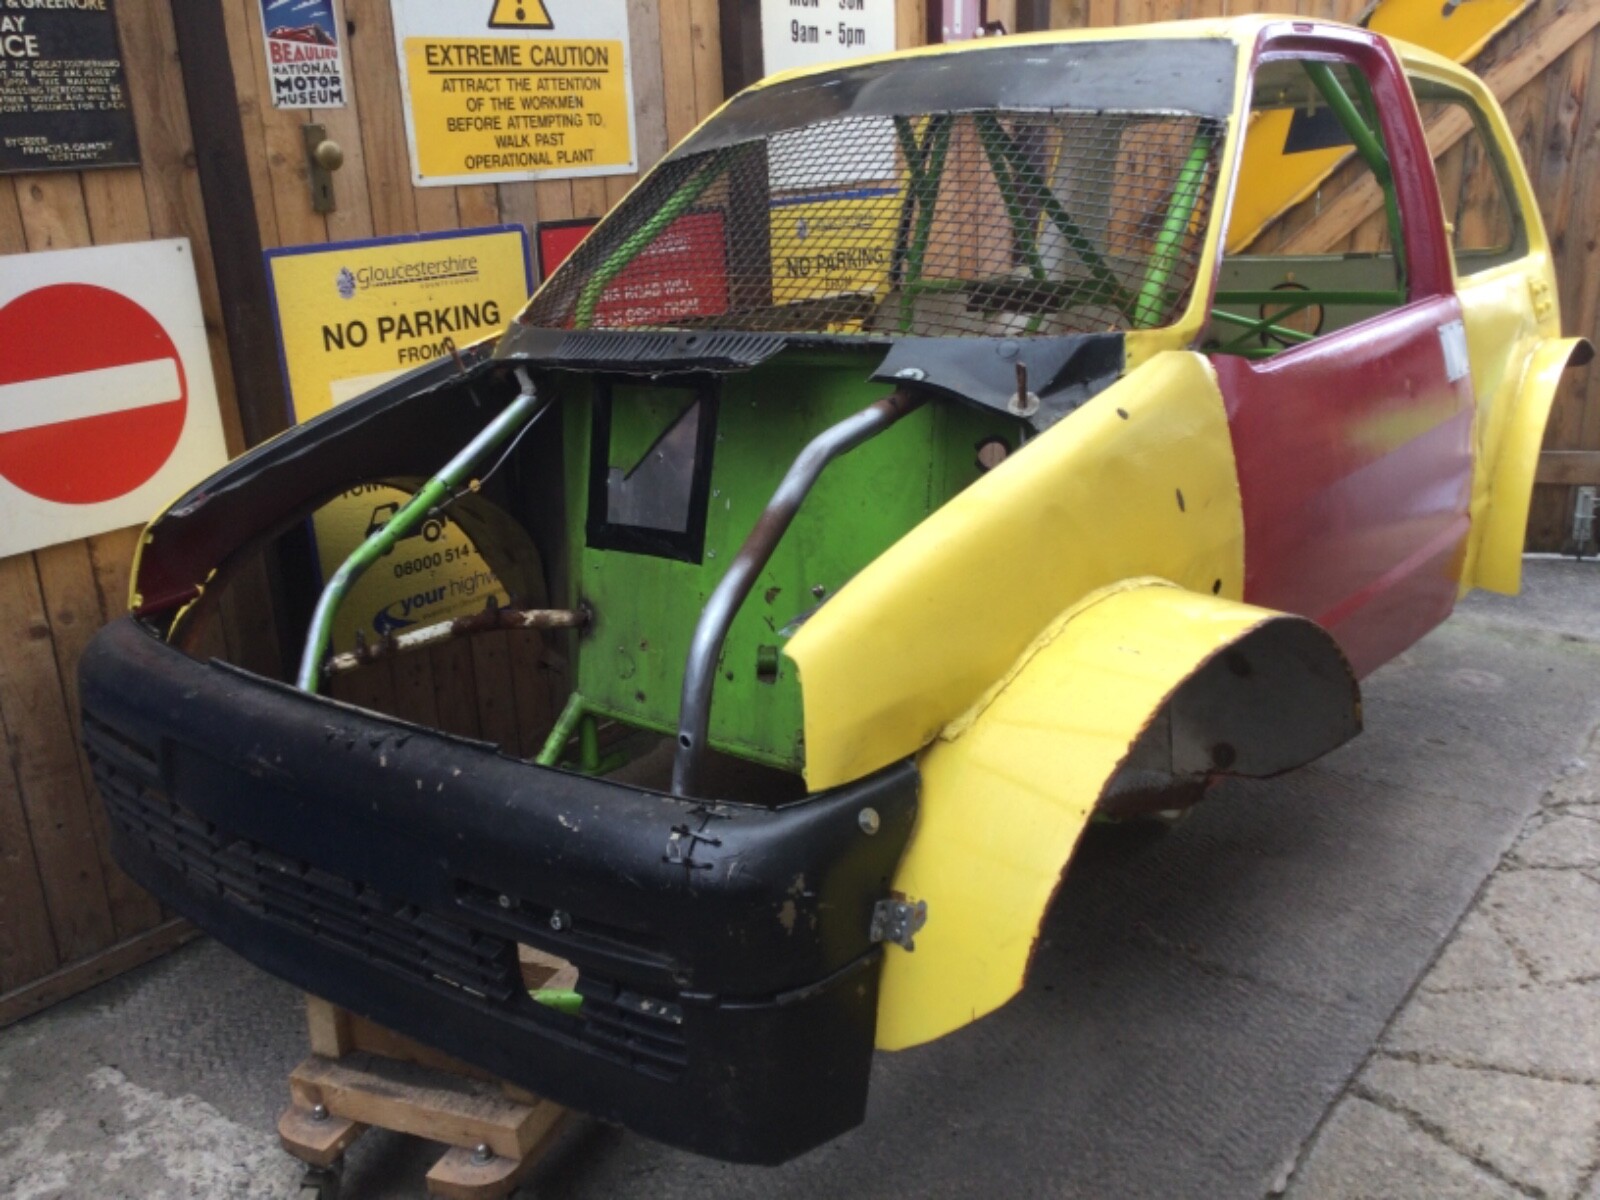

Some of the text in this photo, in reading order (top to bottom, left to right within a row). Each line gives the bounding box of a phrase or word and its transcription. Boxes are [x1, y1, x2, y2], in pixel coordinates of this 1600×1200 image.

[791, 19, 819, 43] 9am
[838, 22, 865, 48] 5pm
[269, 41, 338, 64] BEAULIEU
[425, 45, 609, 67] EXTREME CAUTION
[272, 61, 339, 75] NATIONAL
[274, 76, 341, 93] MOTOR
[441, 77, 602, 93] ATTRACT THE ATTENTION
[276, 88, 344, 105] MUSEUM
[466, 95, 584, 112] OF THE WORKMEN
[446, 113, 602, 132] BEFORE ATTEMPTING TO
[494, 132, 565, 149] WALK PAST
[464, 148, 594, 169] OPERATIONAL PLANT
[814, 245, 884, 273] PARKING
[322, 300, 501, 352] NO PARKING
[394, 552, 441, 579] 08000
[401, 585, 447, 618] your
